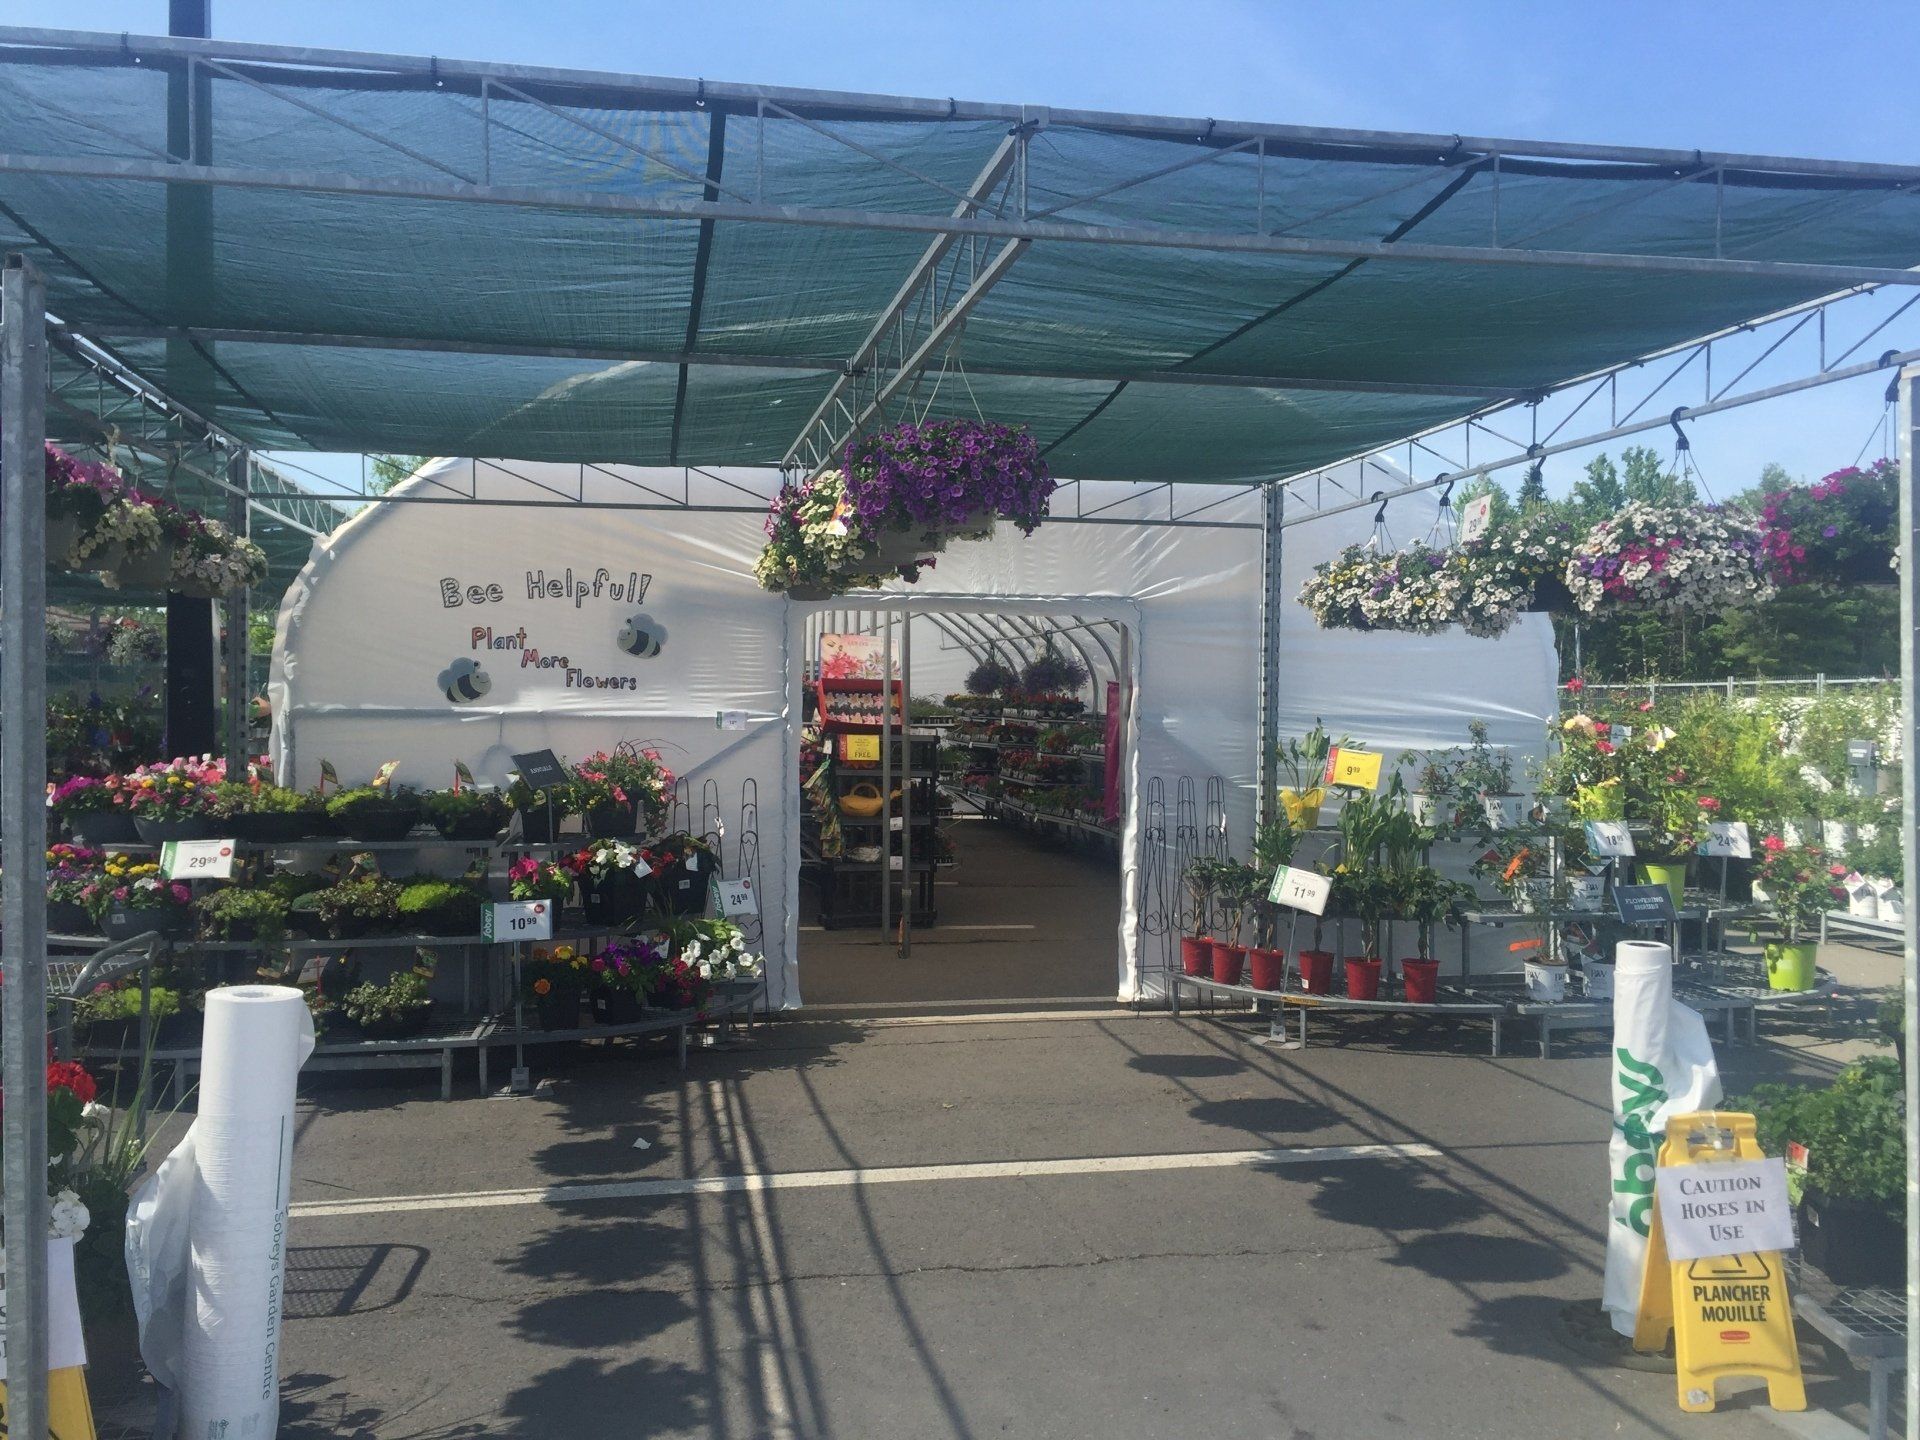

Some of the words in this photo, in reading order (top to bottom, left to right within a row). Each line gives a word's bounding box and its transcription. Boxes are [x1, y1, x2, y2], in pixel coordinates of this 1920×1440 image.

[440, 577, 504, 608] Bee
[526, 568, 652, 608] Helpful!
[471, 626, 527, 650] Plant
[520, 648, 569, 668] More
[565, 668, 637, 690] Flowers
[1679, 1176, 1762, 1196] CAUTION
[1681, 1202, 1739, 1221] HOSES
[1745, 1199, 1766, 1214] IN
[268, 1211, 283, 1271] Sobeys
[1709, 1225, 1745, 1242] USE
[1693, 1285, 1771, 1302] PLANCHER
[265, 1274, 281, 1339] Garden
[1702, 1302, 1767, 1322] MOUILLÉ
[262, 1341, 276, 1400] Centre
